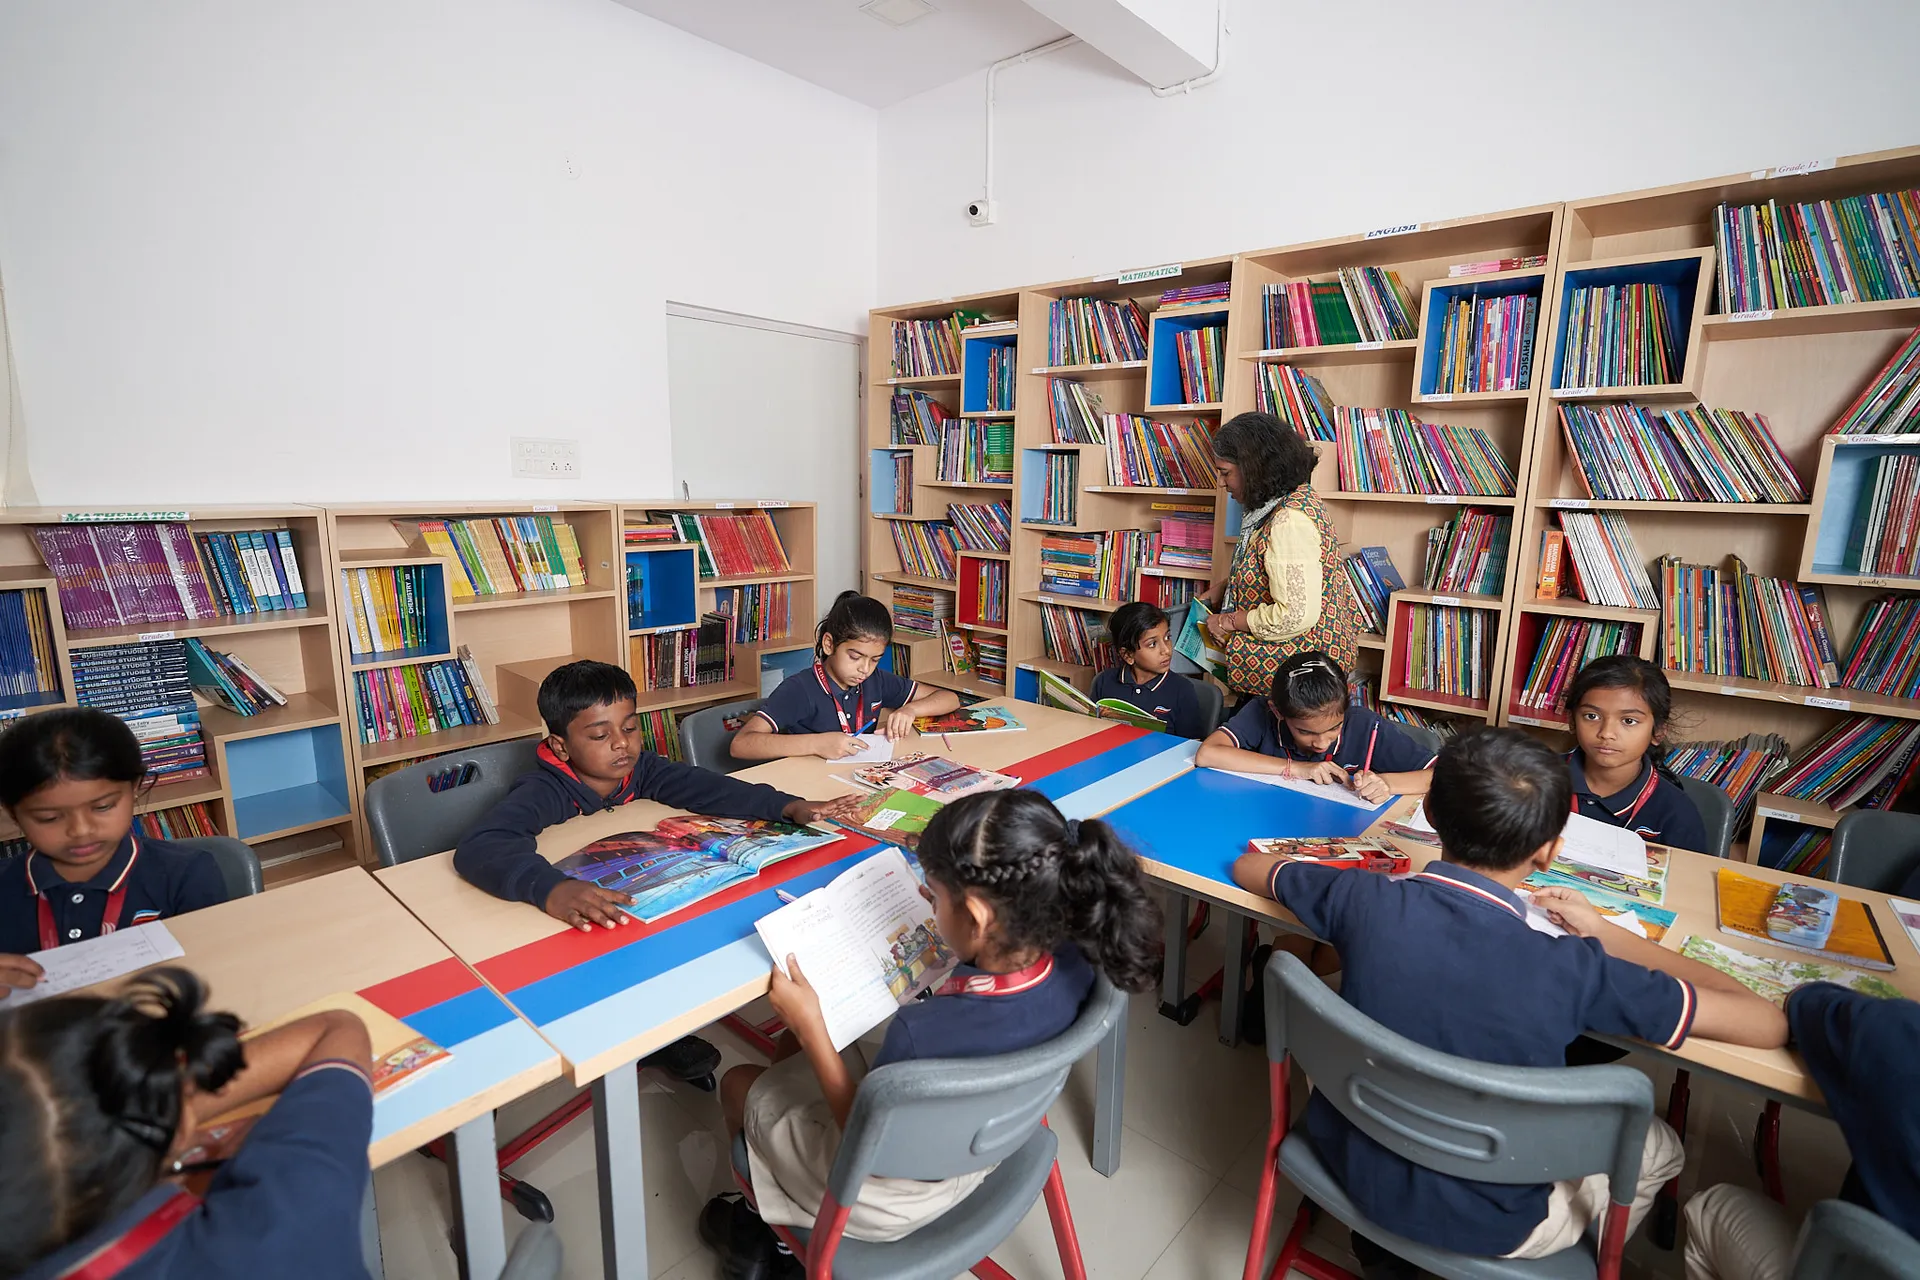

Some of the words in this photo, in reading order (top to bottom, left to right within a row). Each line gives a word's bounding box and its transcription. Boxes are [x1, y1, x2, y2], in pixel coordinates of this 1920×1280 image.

[1778, 164, 1805, 173] Grade
[1368, 224, 1418, 238] ENGLISH
[1120, 266, 1179, 282] MATHEMATICS
[1520, 339, 1530, 376] PHYSICS
[66, 512, 186, 522] MATHEMATICS
[1549, 543, 1559, 573] MANORAMA
[213, 542, 225, 565] STATISTICS
[224, 573, 236, 598] ECONOMICS
[405, 581, 414, 613] CHEMISTRY
[121, 669, 150, 677] STUDIES
[86, 680, 121, 688] BUSINESS
[122, 676, 152, 684] STUDIES
[426, 670, 436, 690] BUSINESS
[432, 690, 442, 708] STUDIES
[444, 666, 457, 686] BUSINESS
[452, 686, 463, 704] STUDIES
[87, 688, 122, 696] BUSINESS
[124, 683, 154, 691] STUDIES
[90, 694, 125, 702] BUSINESS
[126, 690, 156, 698] STUDIES
[92, 700, 127, 708] BUSINESS
[128, 696, 157, 704] STUDIES
[130, 702, 159, 710] STUDIES
[413, 689, 424, 716] Accountancy
